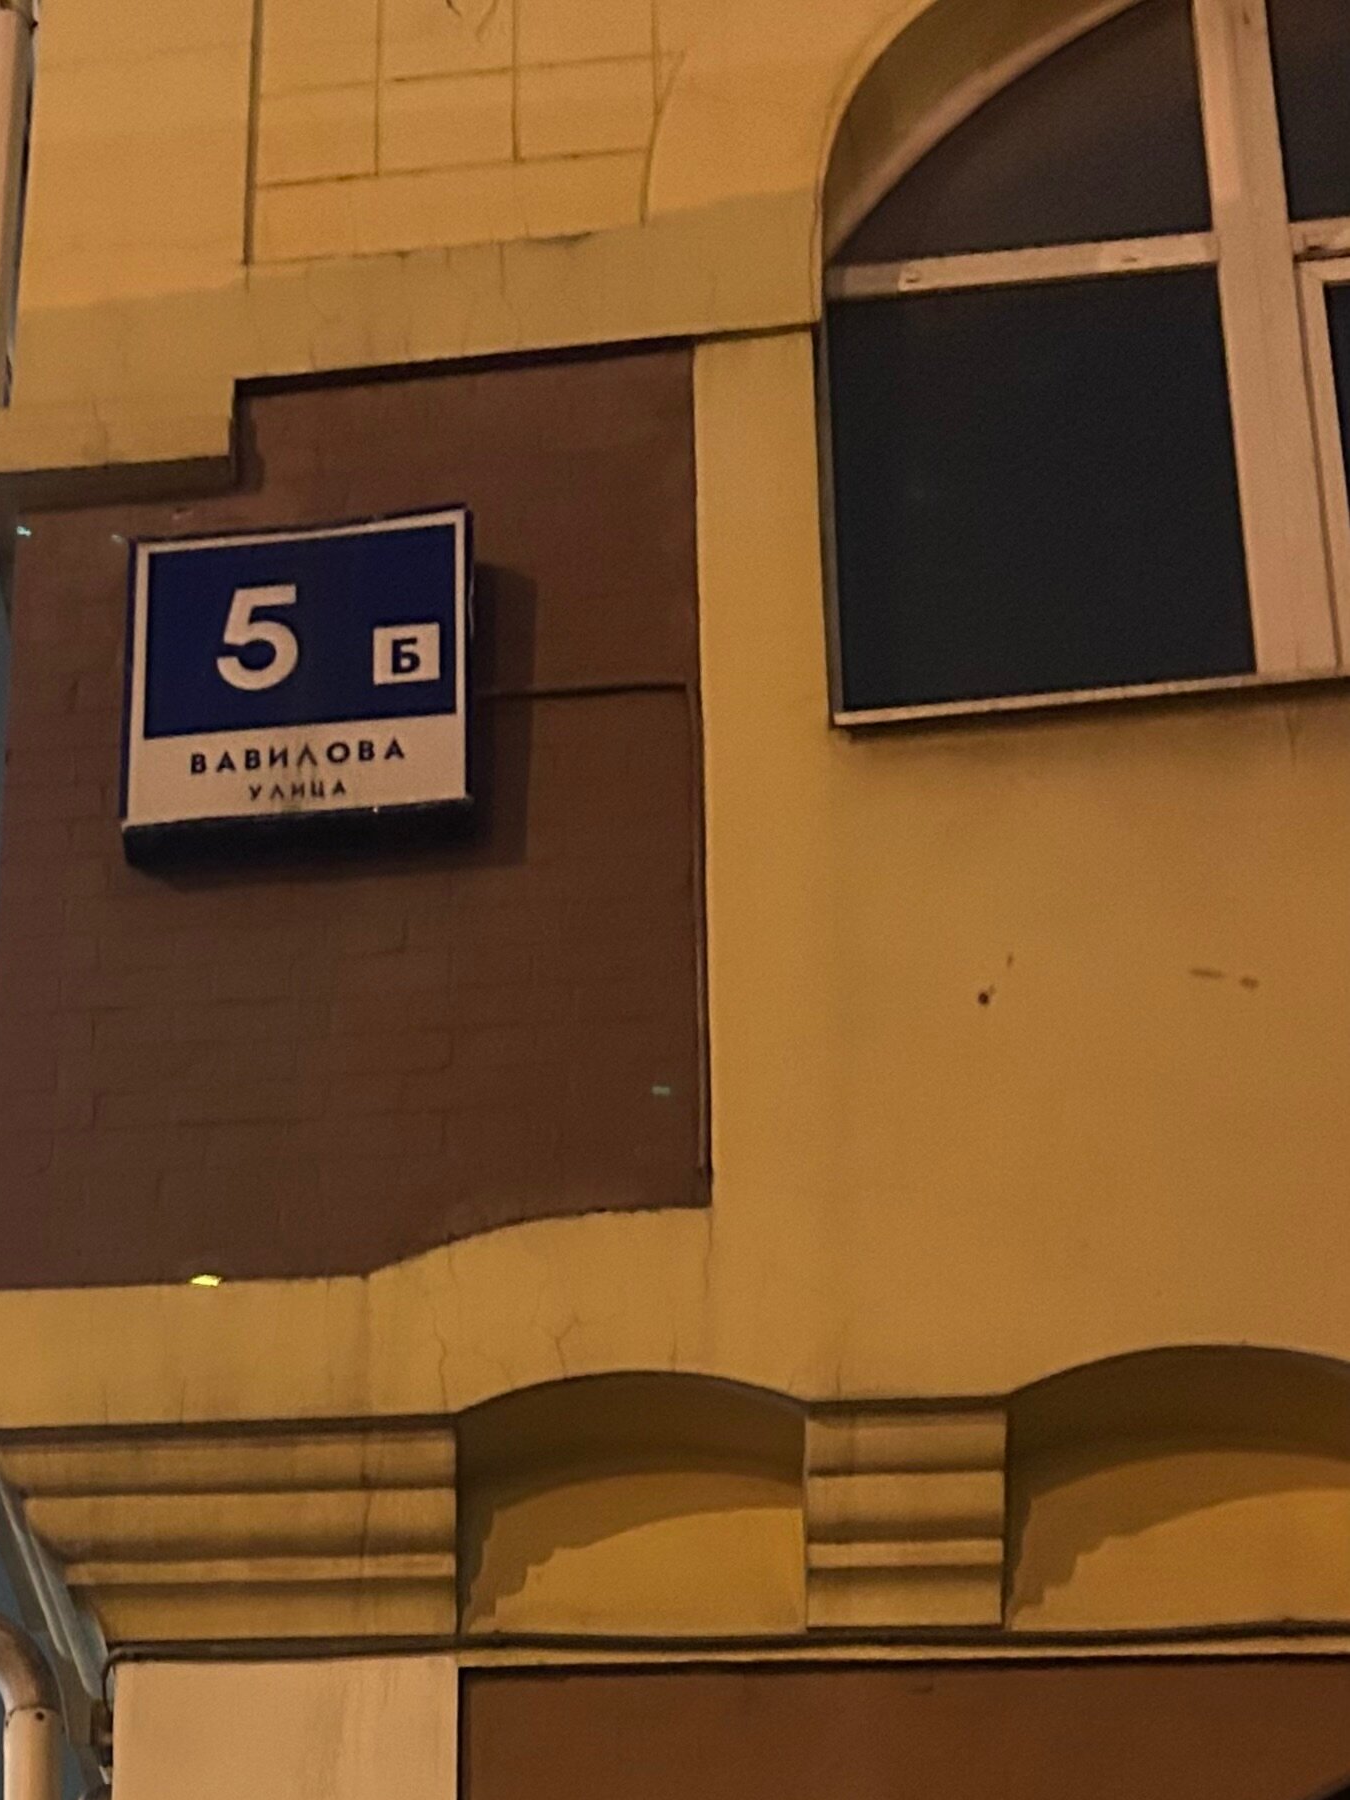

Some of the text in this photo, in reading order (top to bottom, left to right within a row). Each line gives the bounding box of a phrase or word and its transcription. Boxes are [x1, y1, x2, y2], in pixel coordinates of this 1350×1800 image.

[216, 583, 421, 691] 5 Б
[190, 737, 405, 776] ВАВИЛОВА
[250, 780, 346, 800] УЛИЦА
